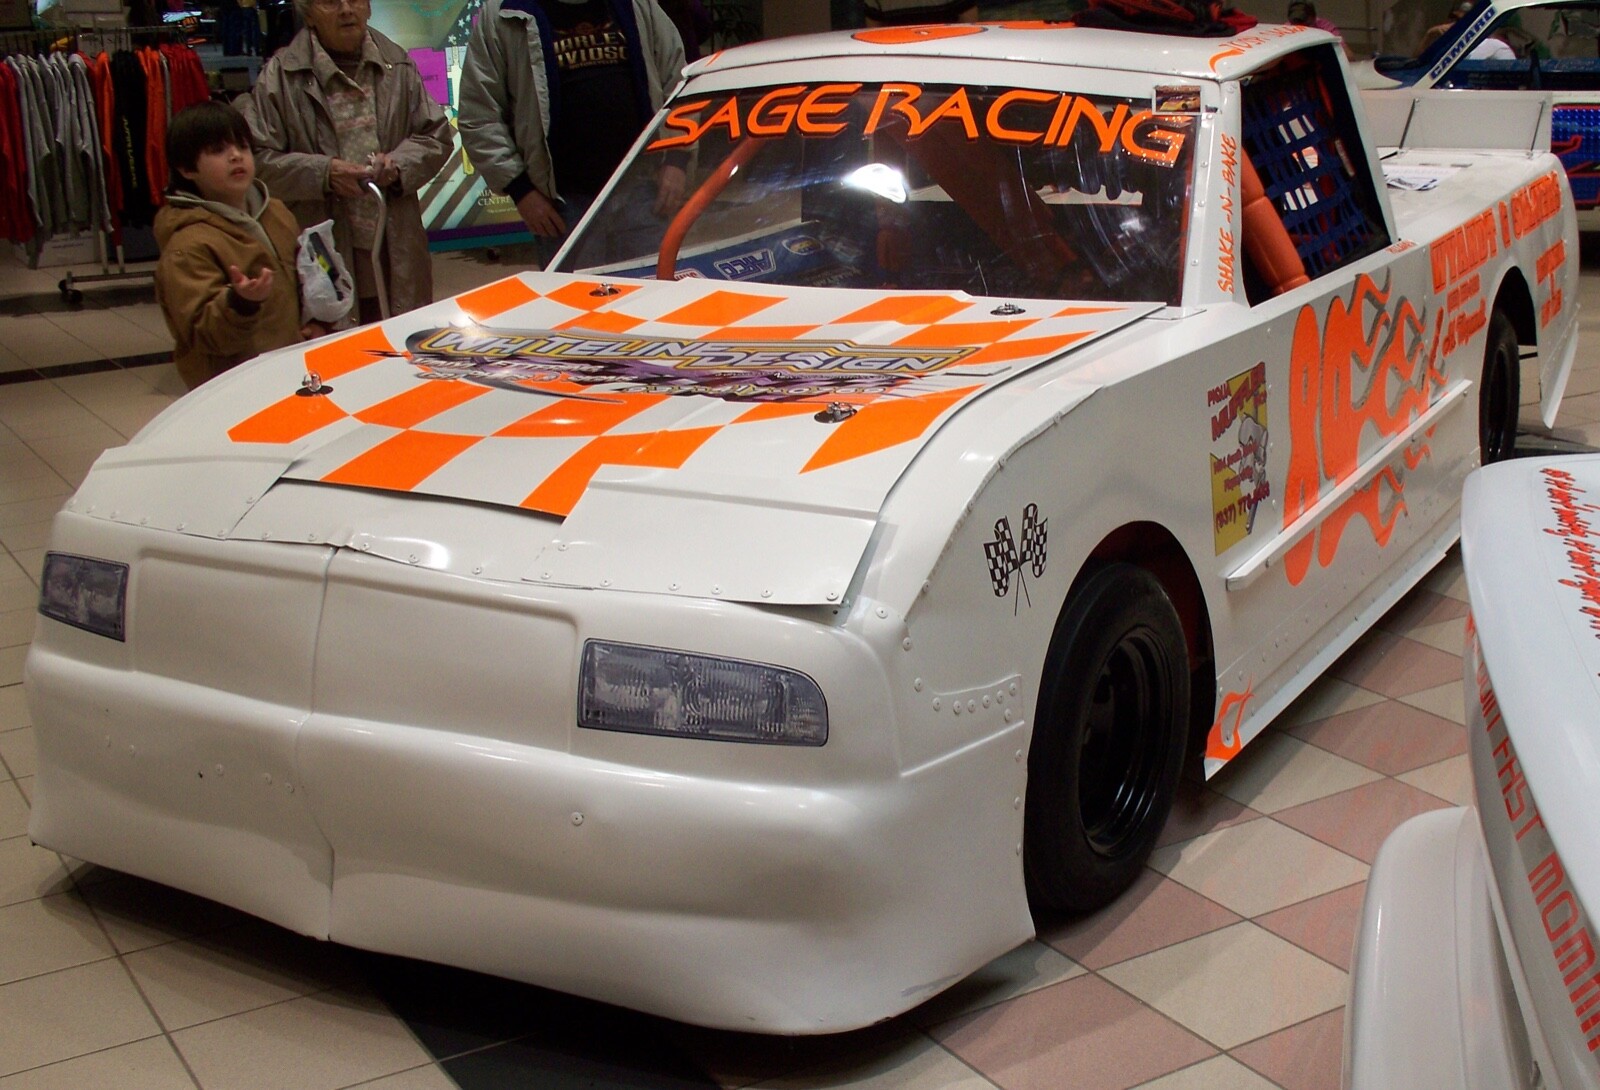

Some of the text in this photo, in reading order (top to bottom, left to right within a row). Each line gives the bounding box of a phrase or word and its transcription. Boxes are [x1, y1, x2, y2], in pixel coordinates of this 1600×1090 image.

[1430, 6, 1495, 79] CAMARO
[646, 82, 1191, 168] SAGE RACING
[1220, 133, 1238, 187] BAKE
[1217, 227, 1235, 295] SHAKE
[428, 327, 952, 371] WHITELINE DESIGN
[1492, 736, 1547, 841] FAST
